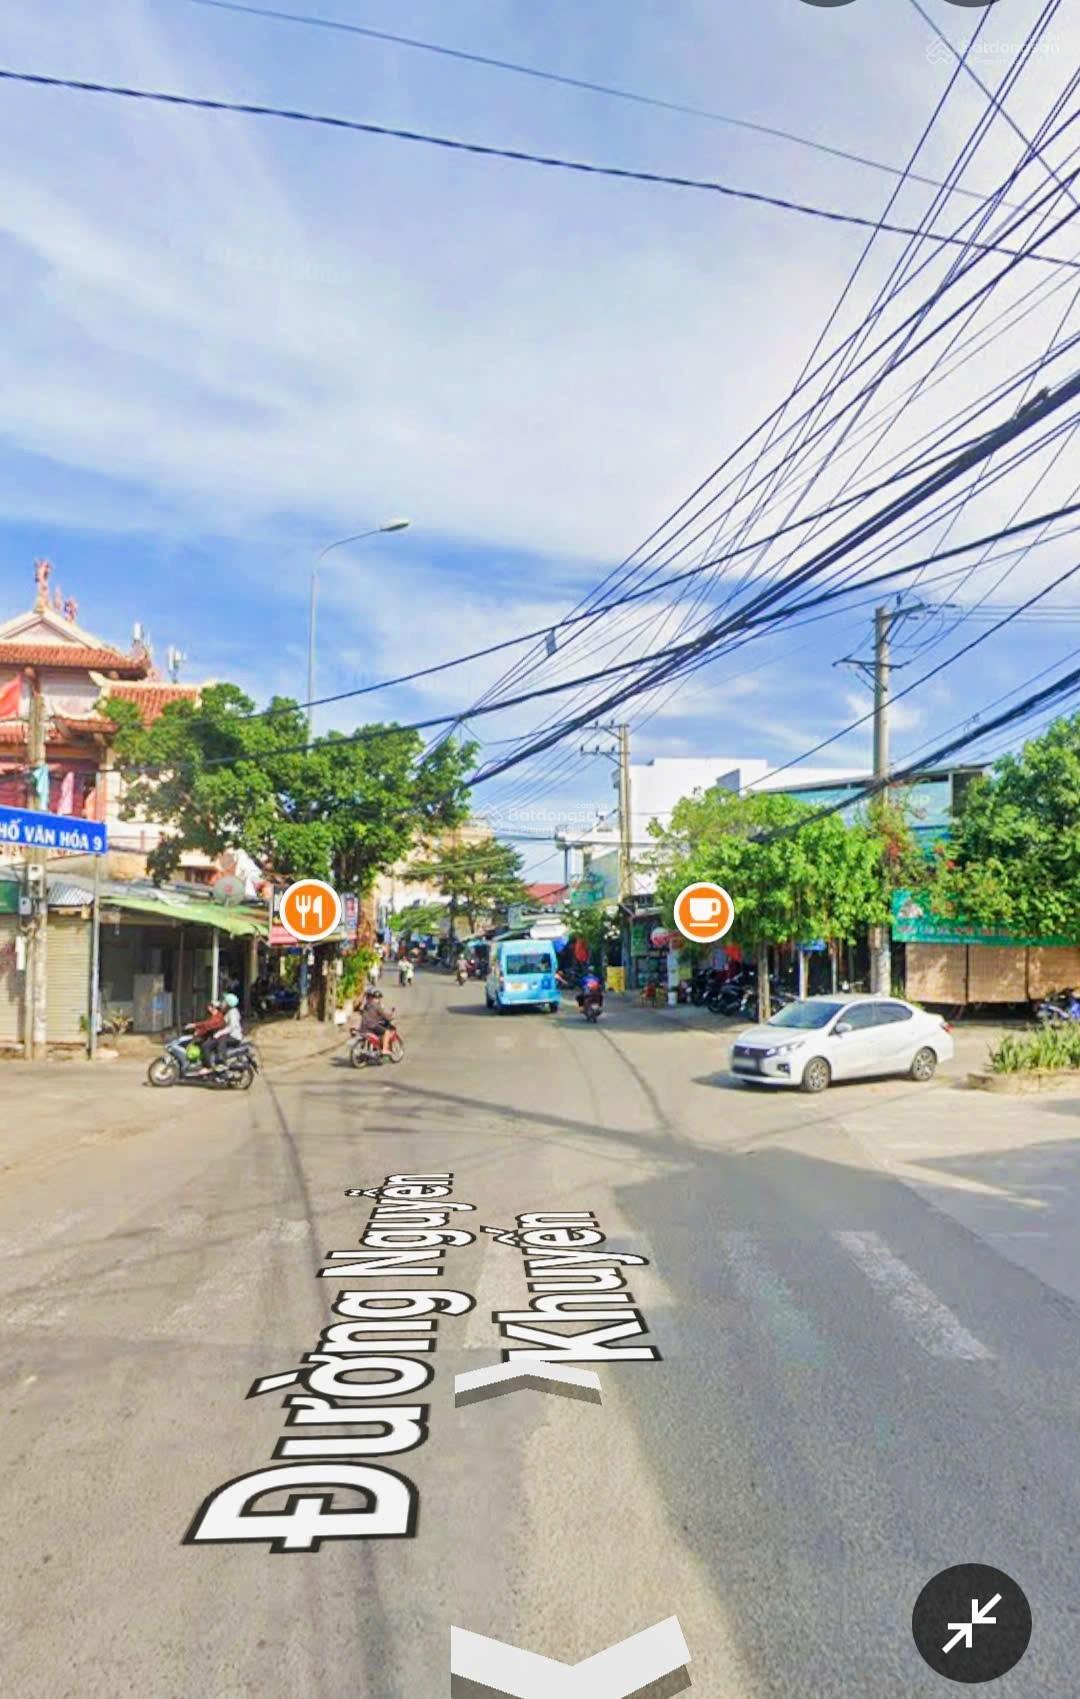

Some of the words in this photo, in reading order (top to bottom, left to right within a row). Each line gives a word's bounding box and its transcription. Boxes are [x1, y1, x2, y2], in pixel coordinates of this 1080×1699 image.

[0, 818, 20, 841] HỐ
[24, 823, 56, 845] VĂN
[60, 828, 89, 850] HÓA
[93, 836, 103, 851] 9
